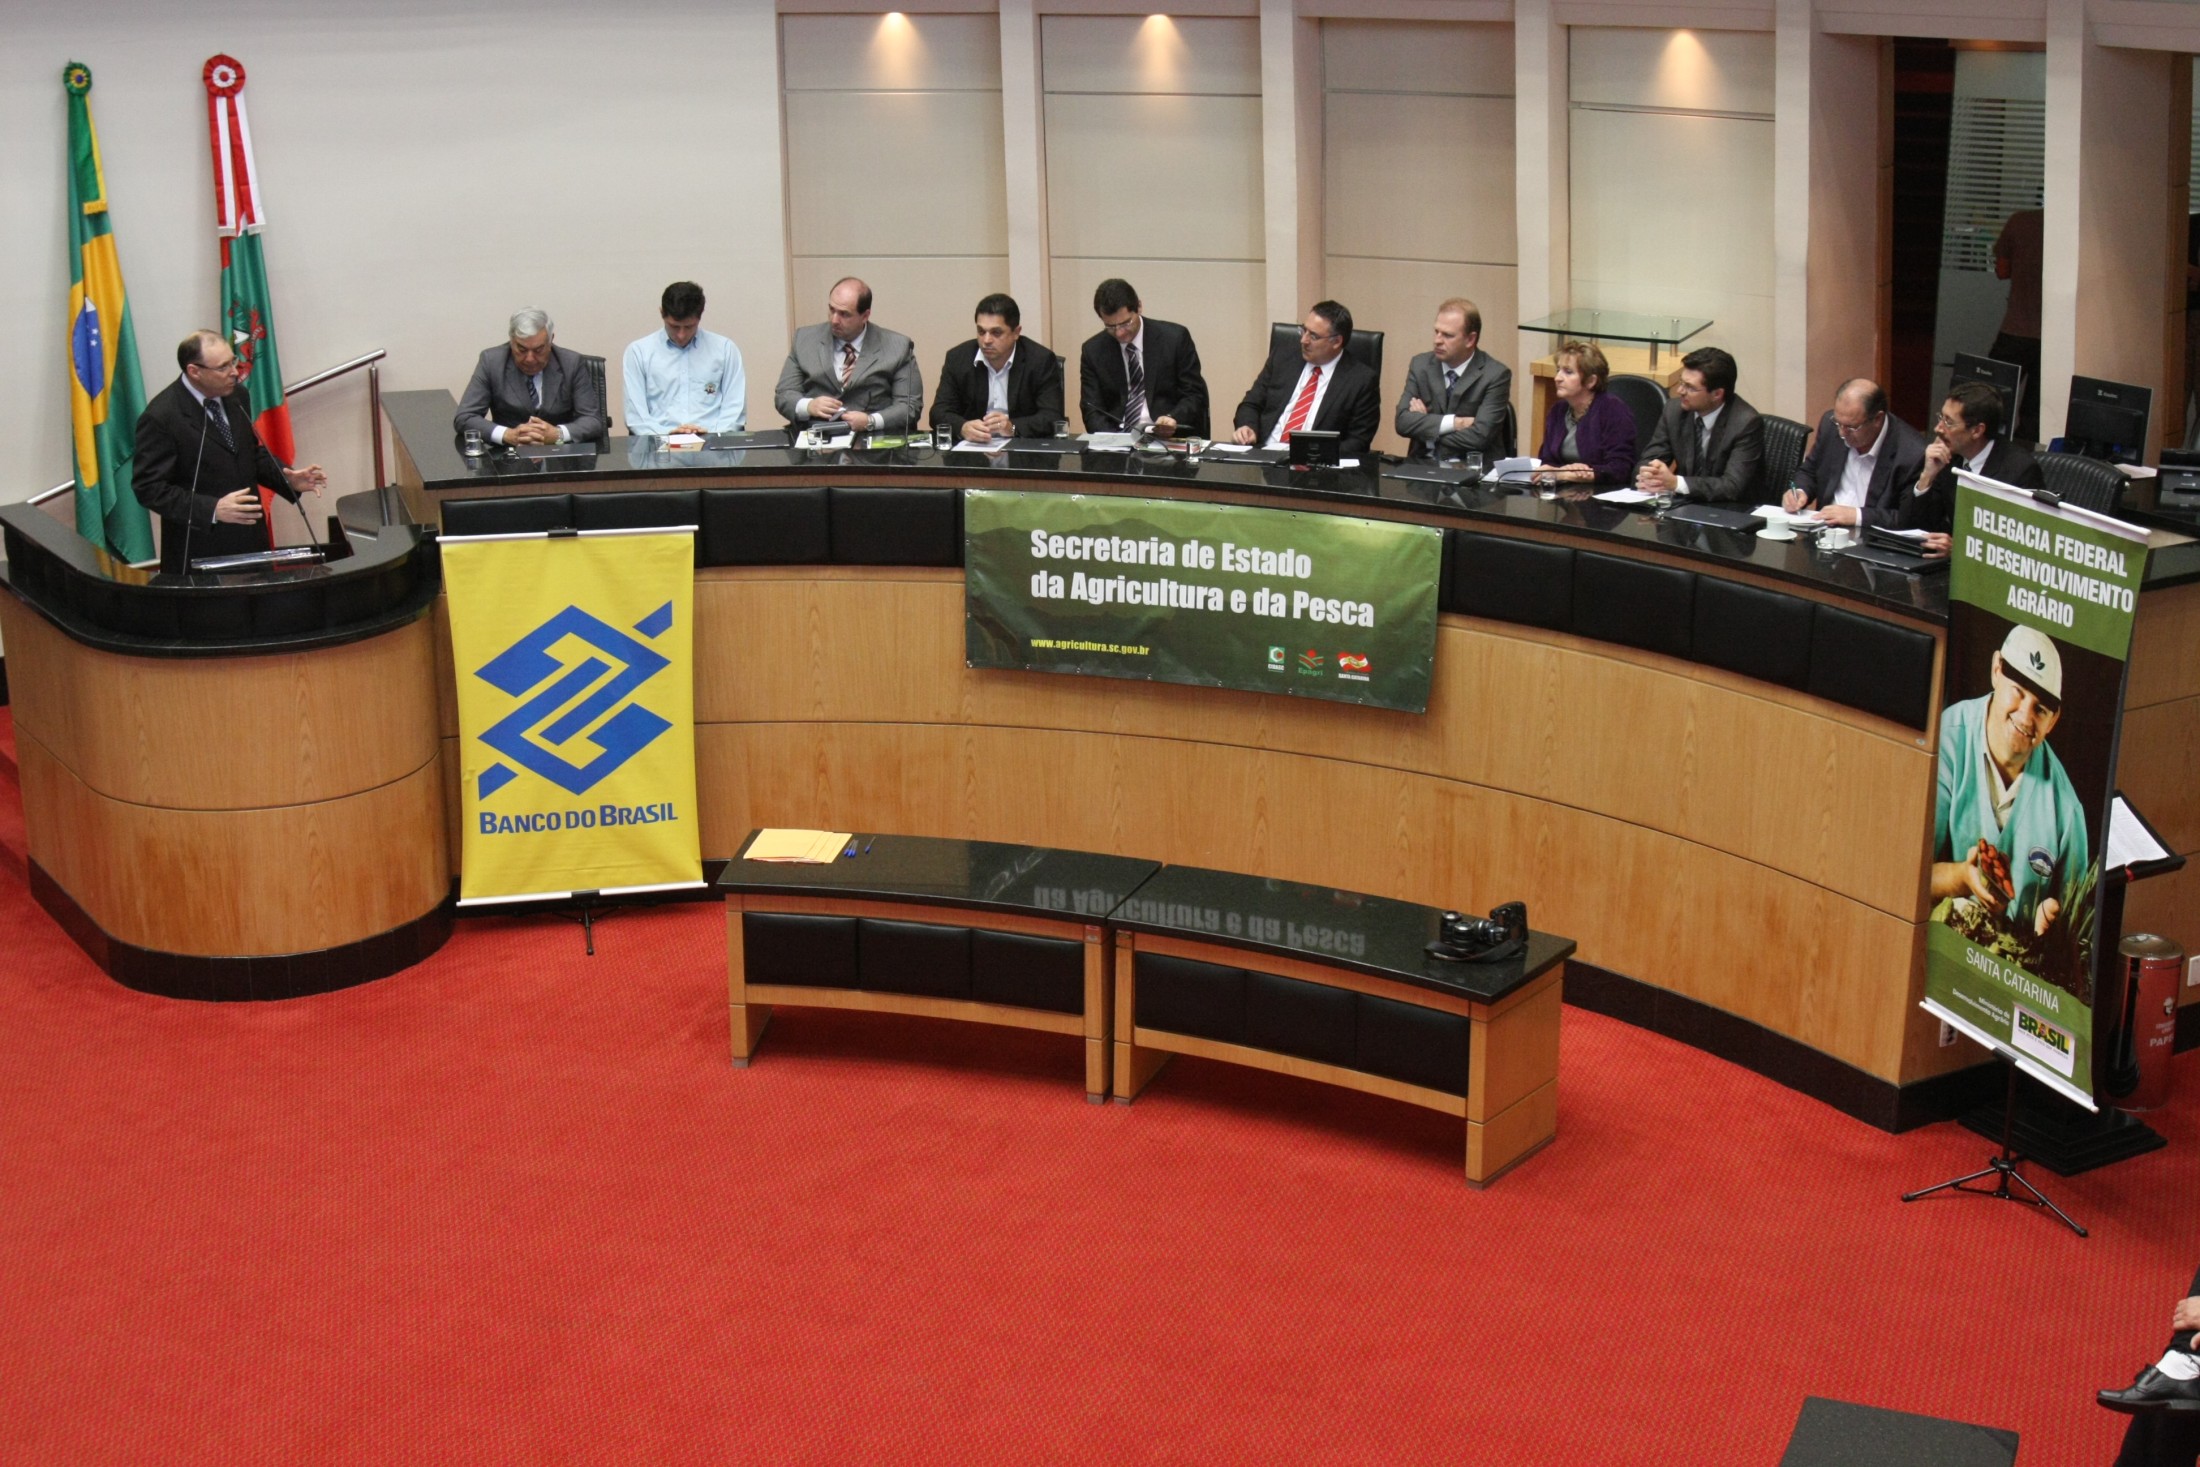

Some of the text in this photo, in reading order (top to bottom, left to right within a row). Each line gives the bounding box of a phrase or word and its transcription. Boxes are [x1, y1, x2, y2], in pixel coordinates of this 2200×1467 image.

[1031, 528, 1312, 579] Secretaria de Estado
[1973, 505, 2128, 578] DELEGACIA FEDERAL
[1031, 570, 1374, 628] da Agricultura e da Pesca
[1965, 535, 2134, 613] DE DESENVOLVIMENTO
[2006, 585, 2074, 628] AGRÁRIO
[1031, 639, 1150, 655] www.agricultura.sc.gov.br
[479, 802, 678, 834] BANCO DO BRASIL
[1966, 947, 2060, 1014] SANTA CATARINA
[2018, 1010, 2069, 1055] BRASIL
